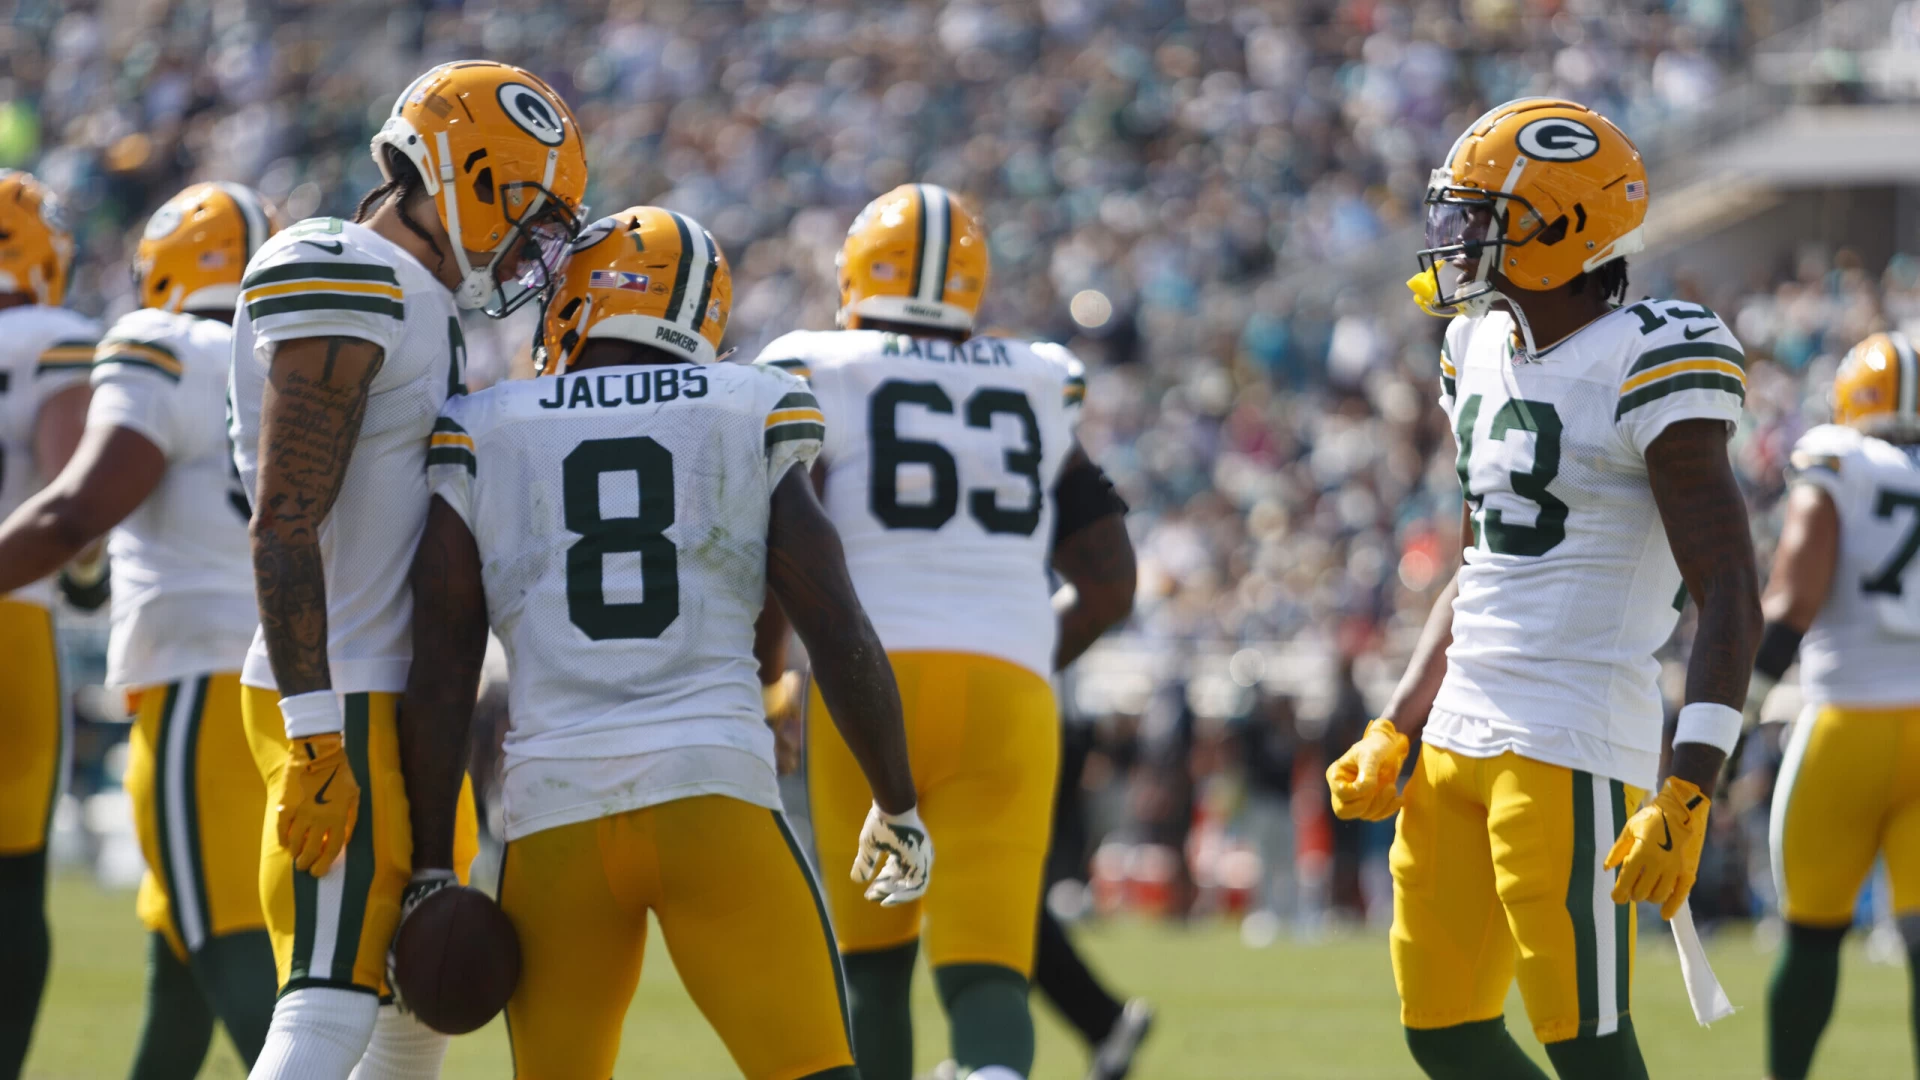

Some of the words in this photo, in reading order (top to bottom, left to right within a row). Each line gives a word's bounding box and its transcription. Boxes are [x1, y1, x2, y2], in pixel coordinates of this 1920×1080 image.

[496, 82, 565, 147] G
[1515, 117, 1600, 163] G
[655, 326, 698, 354] PACKERS
[539, 366, 708, 409] JACOBS
[868, 380, 1043, 537] 63
[1456, 393, 1569, 557] 13
[562, 435, 680, 641] 8
